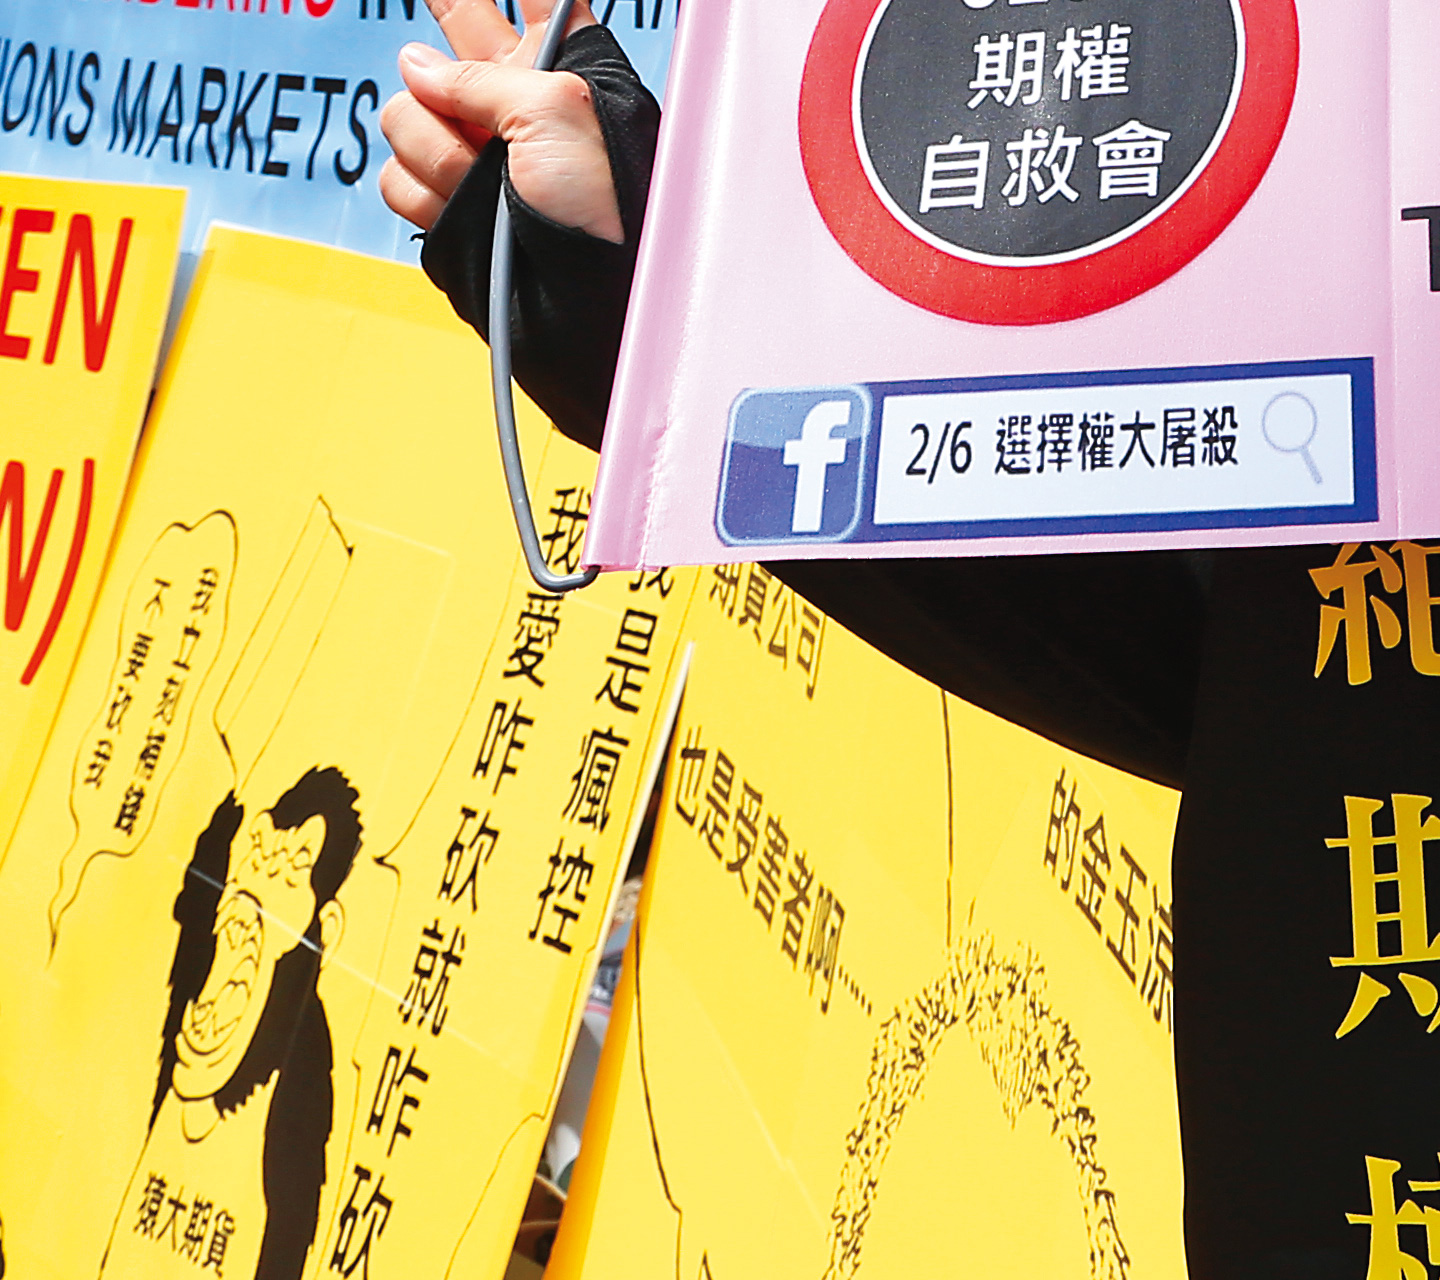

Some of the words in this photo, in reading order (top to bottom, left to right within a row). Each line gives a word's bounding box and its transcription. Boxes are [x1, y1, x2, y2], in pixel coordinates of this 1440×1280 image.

[966, 23, 1133, 111] 期權
[107, 57, 380, 187] MARKETS
[917, 118, 1172, 215] 自救會
[905, 421, 973, 484] 2/6
[994, 406, 1238, 476] 選擇權大屠殺
